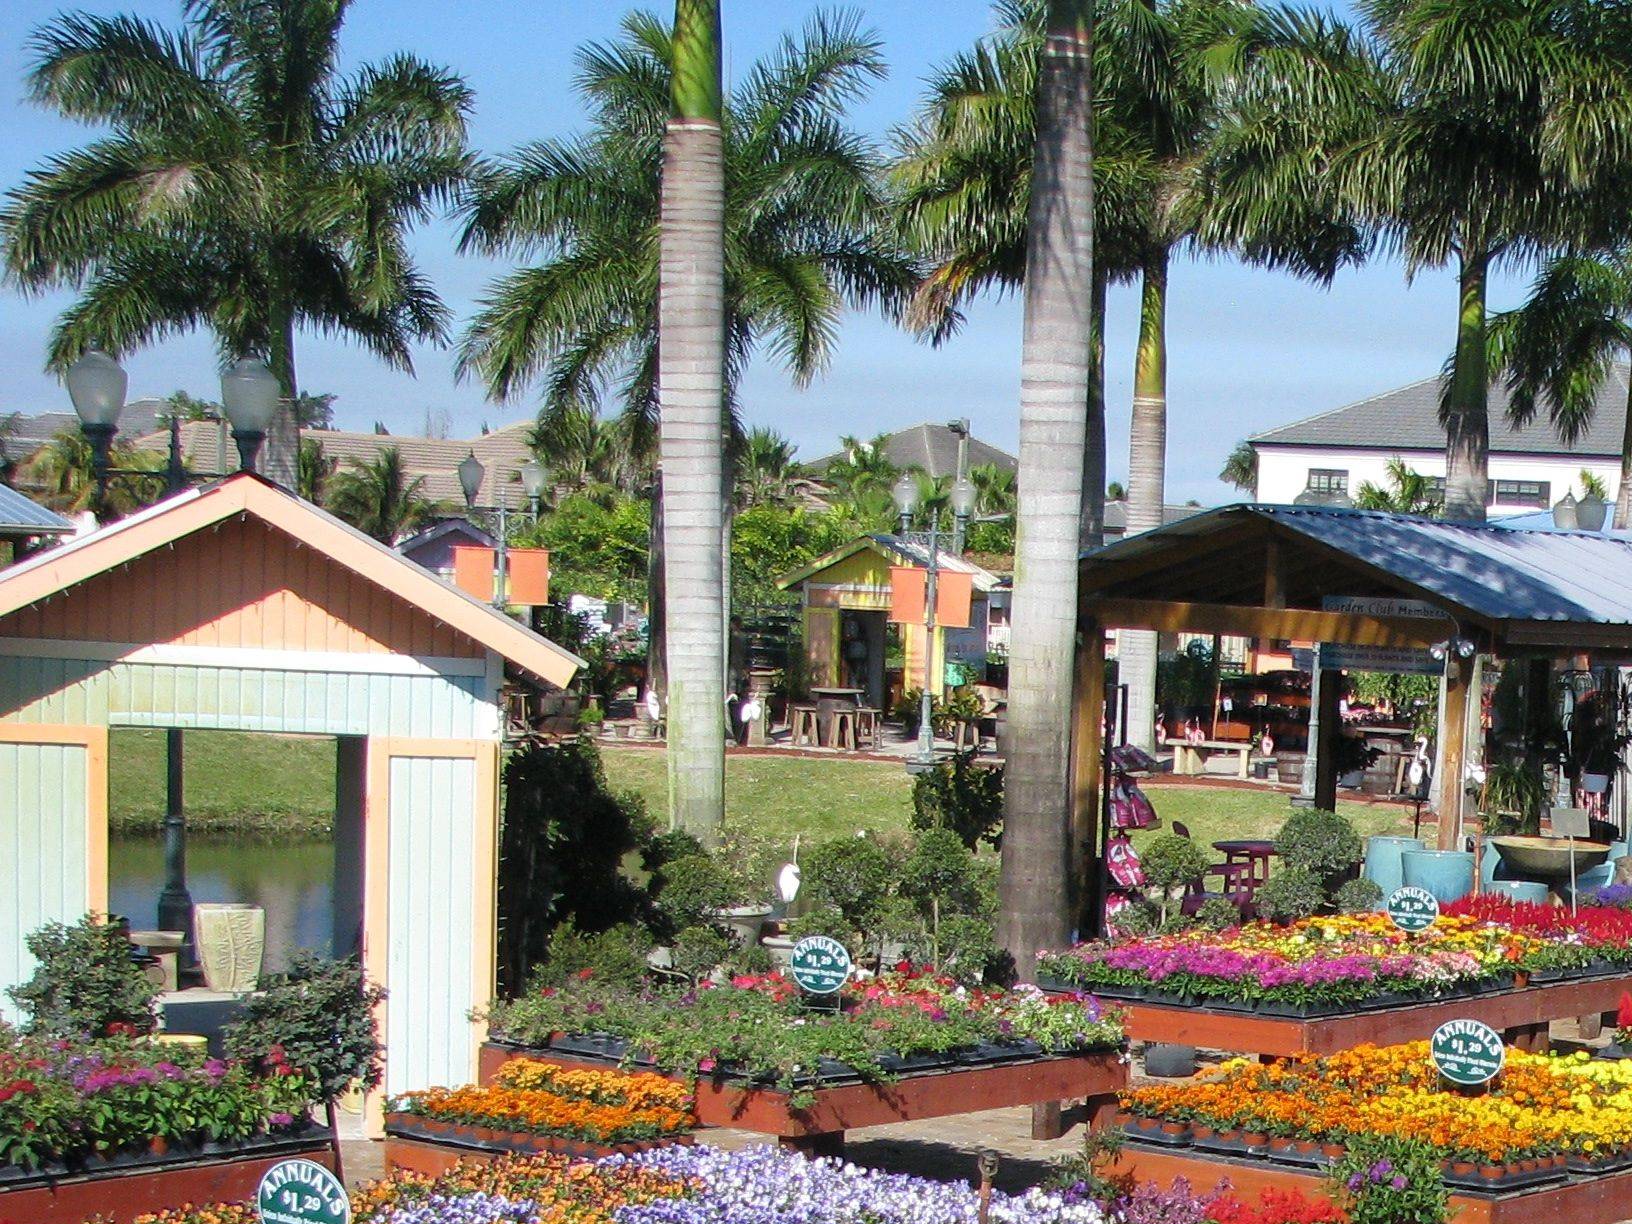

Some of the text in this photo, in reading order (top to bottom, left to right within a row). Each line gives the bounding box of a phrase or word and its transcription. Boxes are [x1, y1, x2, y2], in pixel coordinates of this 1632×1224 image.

[1391, 889, 1435, 911] ANNUALS
[795, 939, 847, 967] ANNUALS
[1436, 1022, 1500, 1055] ANNUALS
[263, 1164, 344, 1216] ANNUALS
